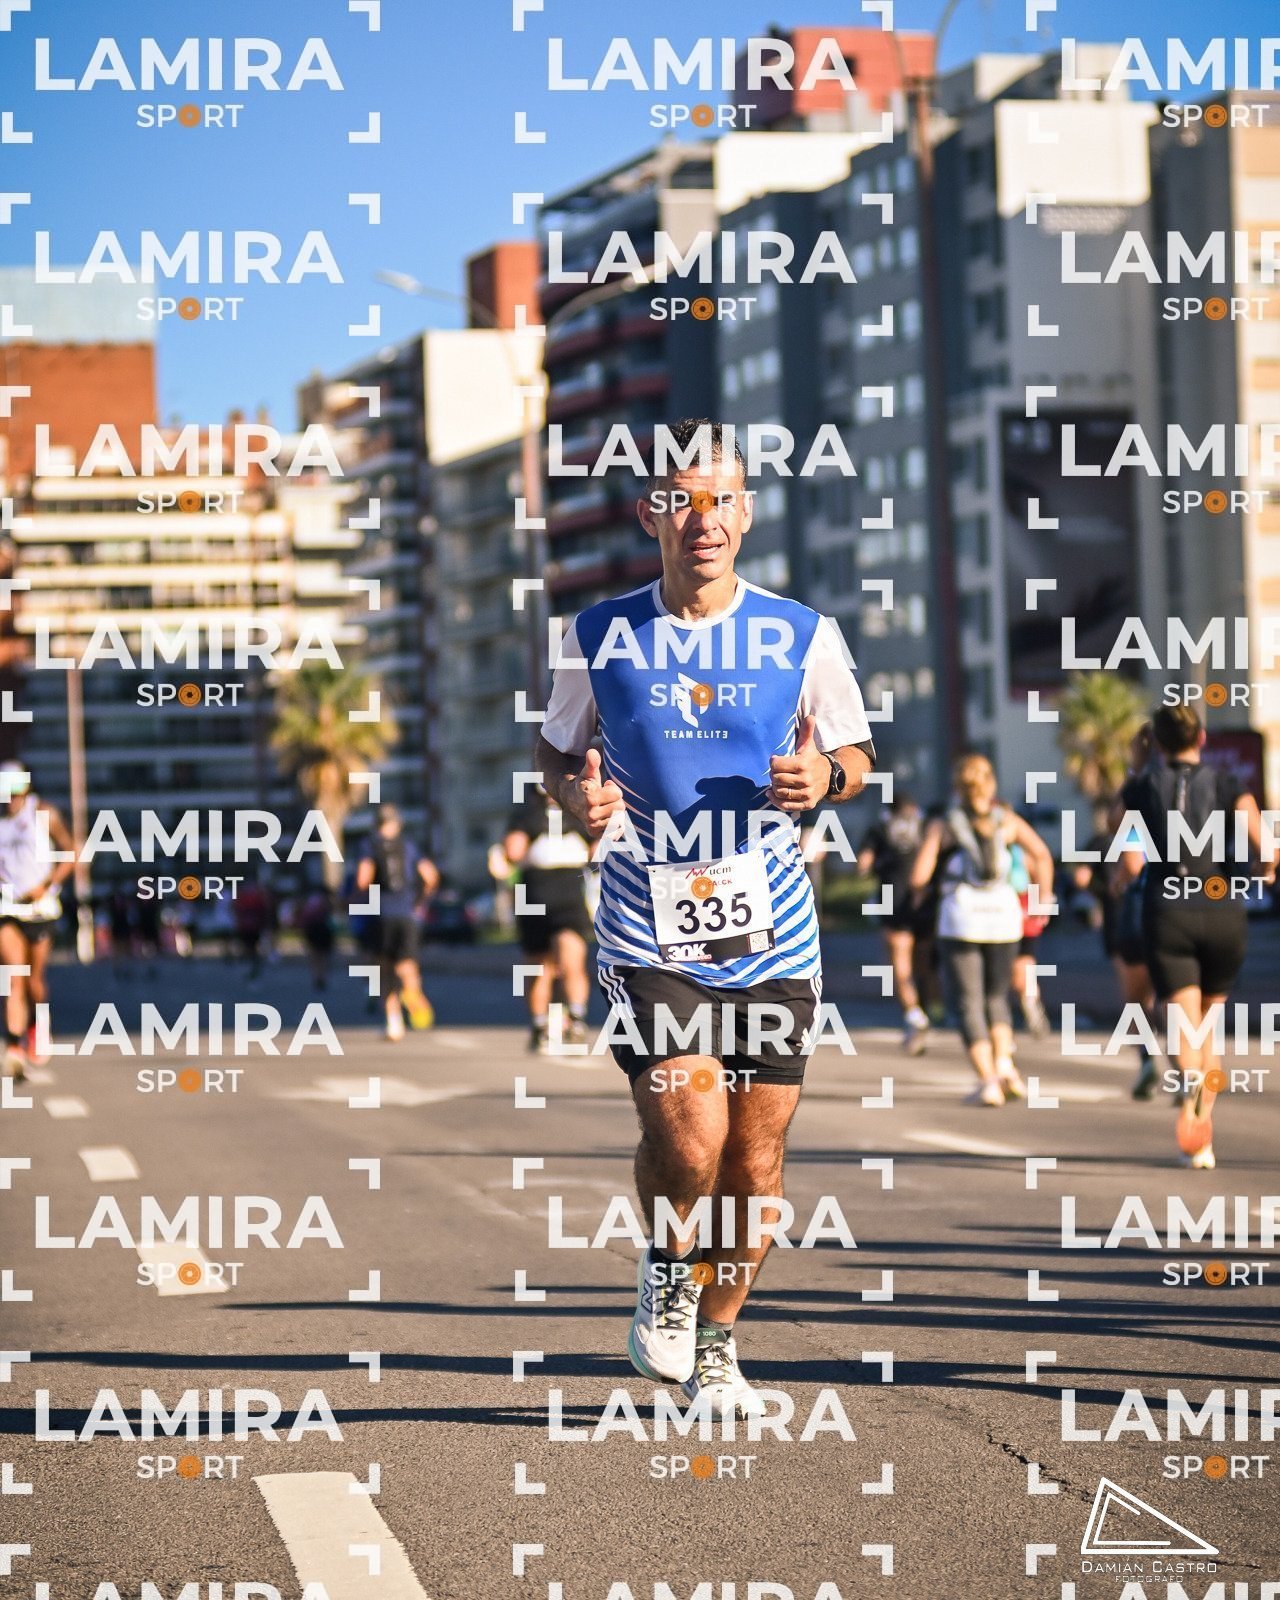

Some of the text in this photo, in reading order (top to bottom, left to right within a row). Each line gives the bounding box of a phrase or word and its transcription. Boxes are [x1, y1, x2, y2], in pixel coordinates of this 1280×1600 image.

[664, 730, 693, 739] TEAM
[709, 866, 732, 876] ucm
[675, 891, 753, 935] 335
[667, 943, 708, 962] 30K
